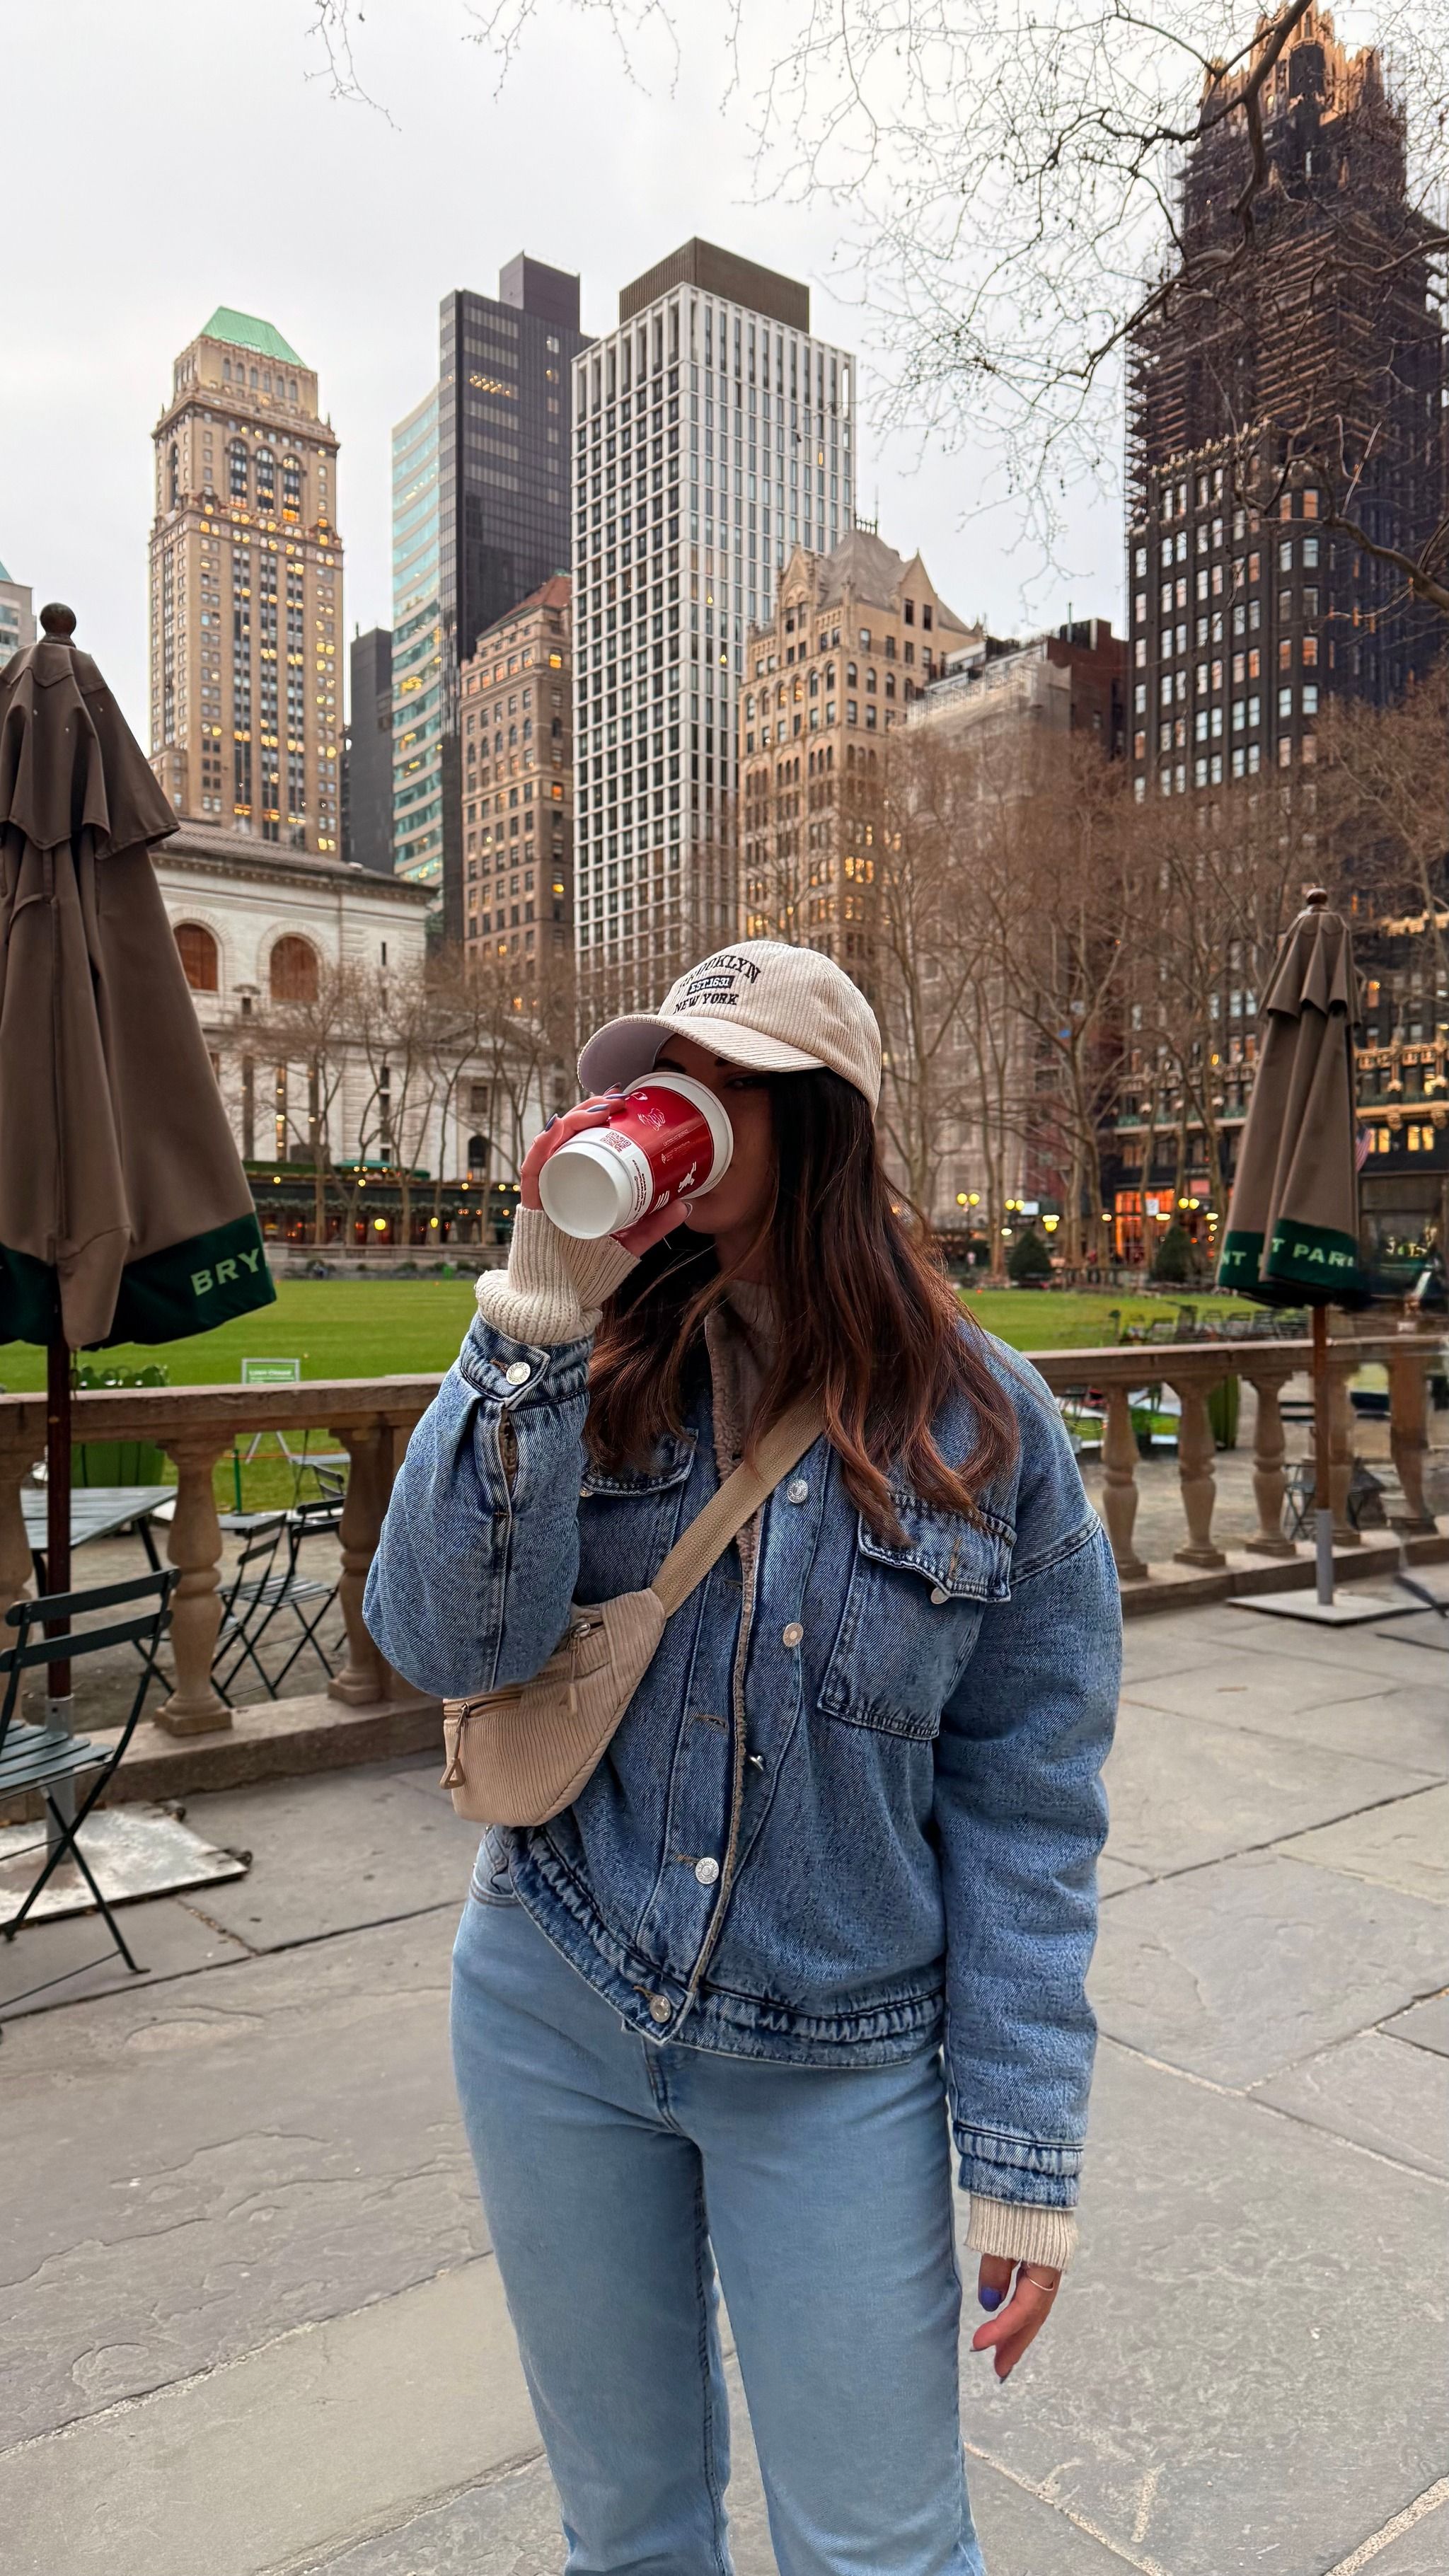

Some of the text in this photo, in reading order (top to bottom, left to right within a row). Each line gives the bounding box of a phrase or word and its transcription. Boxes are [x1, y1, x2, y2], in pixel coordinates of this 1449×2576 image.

[673, 993, 739, 1015] NEW YORK
[190, 1248, 260, 1296] BRY
